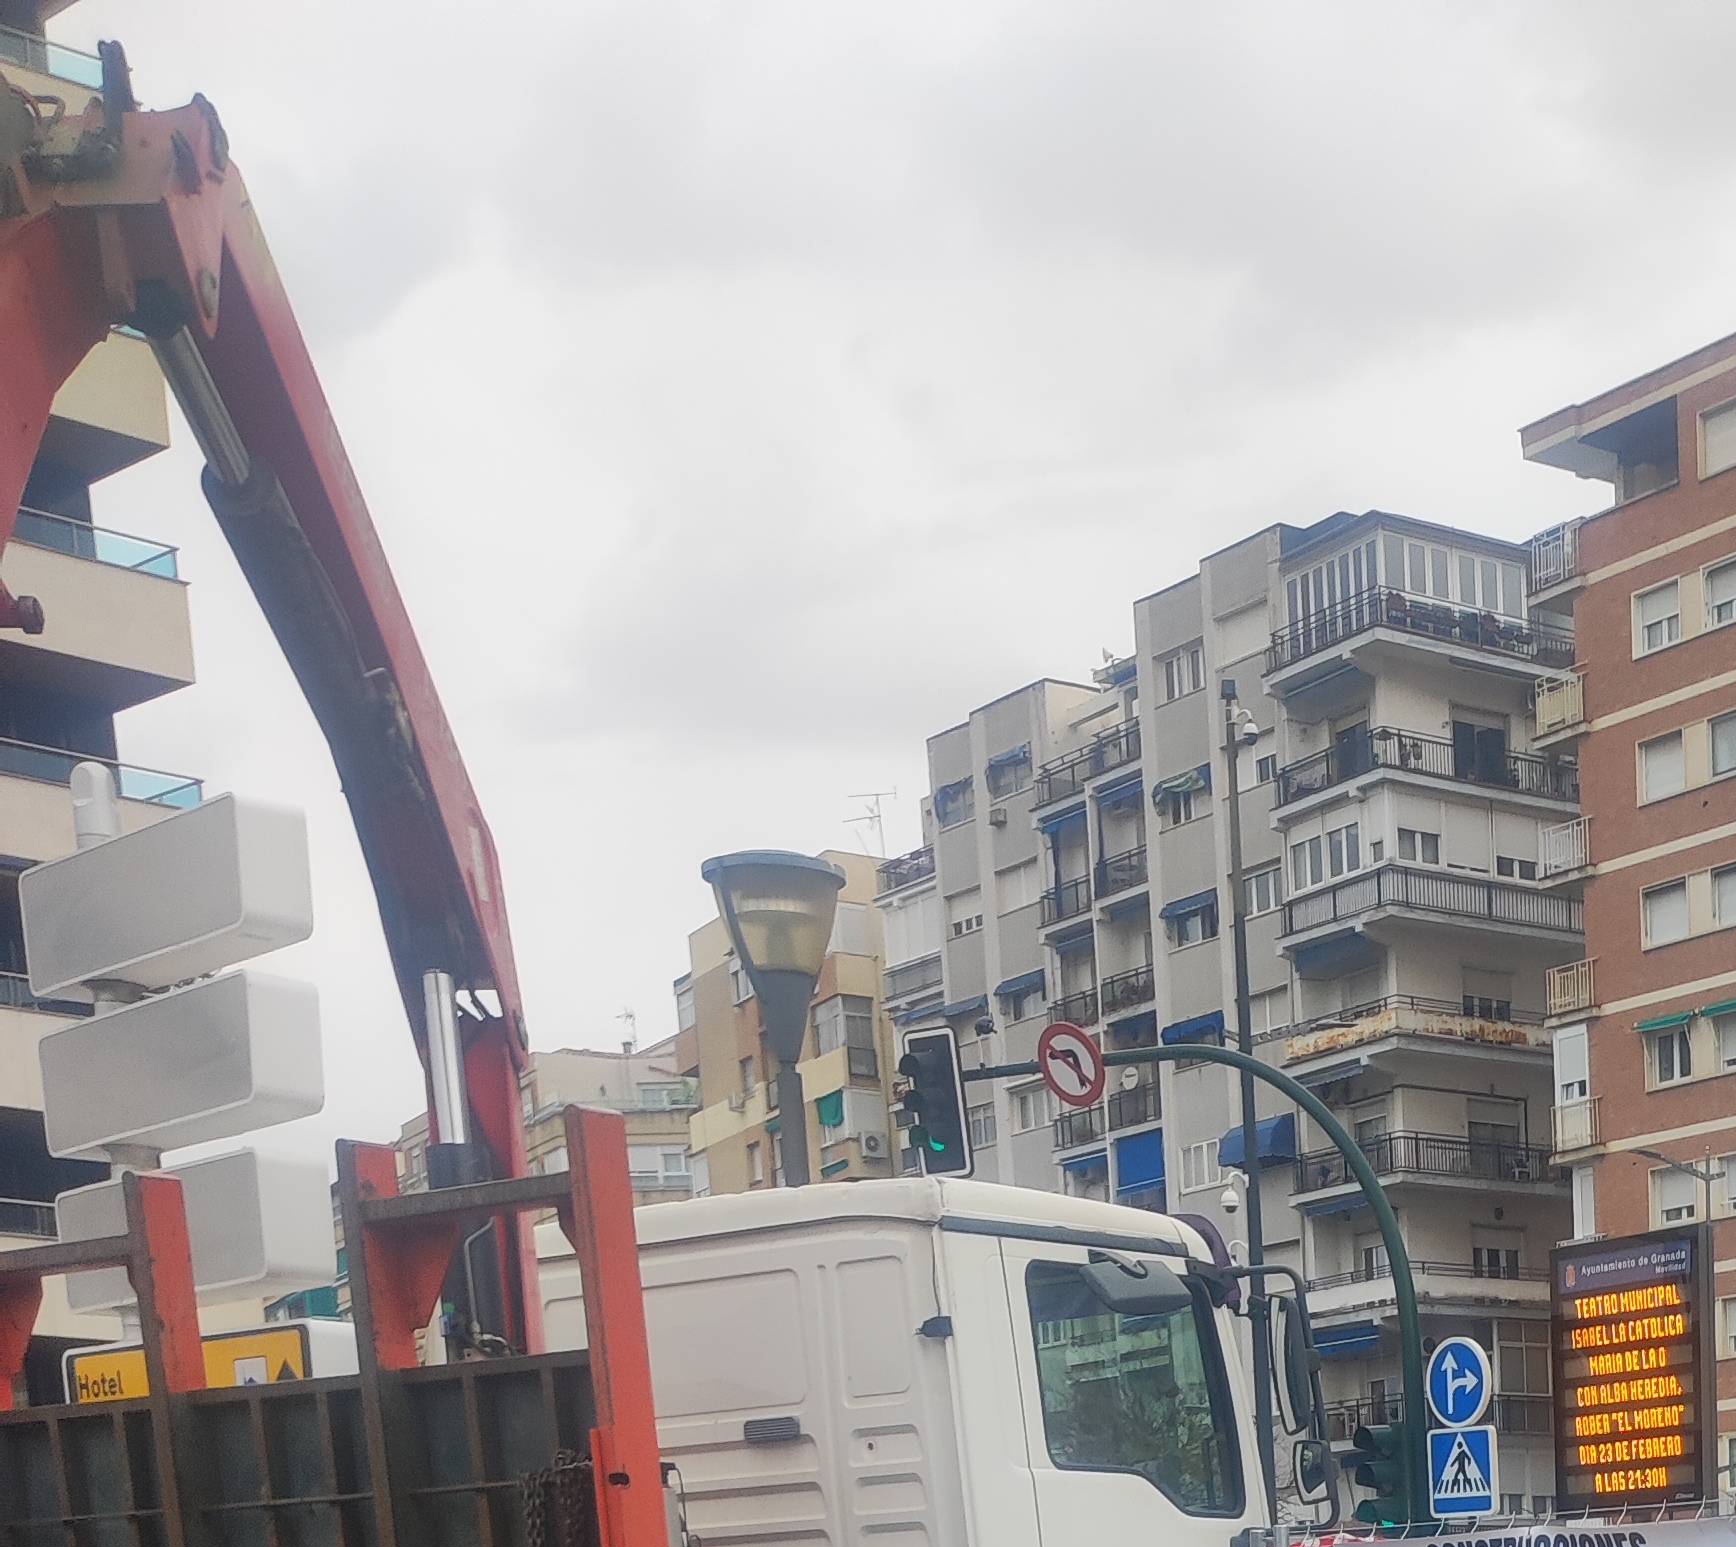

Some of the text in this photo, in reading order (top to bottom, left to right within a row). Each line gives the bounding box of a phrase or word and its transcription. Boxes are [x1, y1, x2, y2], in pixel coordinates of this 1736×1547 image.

[1581, 1249, 1687, 1277] Ayuntamiento de Granada
[1655, 1262, 1687, 1274] Movilidad
[1574, 1283, 1682, 1320] TEATRO MUNICIPAL
[1571, 1313, 1684, 1350] ISABEL LA CATOLICA
[1589, 1352, 1624, 1377] MARIA
[1624, 1349, 1640, 1373] DE
[1641, 1347, 1657, 1370] LA
[79, 1370, 123, 1400] Hotel
[1577, 1375, 1683, 1408] CON ALBA HEREDIA,
[1575, 1413, 1611, 1437] ROBER
[1579, 1434, 1682, 1466] DIA 23 DE FEBRERO
[1595, 1466, 1668, 1494] A LAS 21:30H
